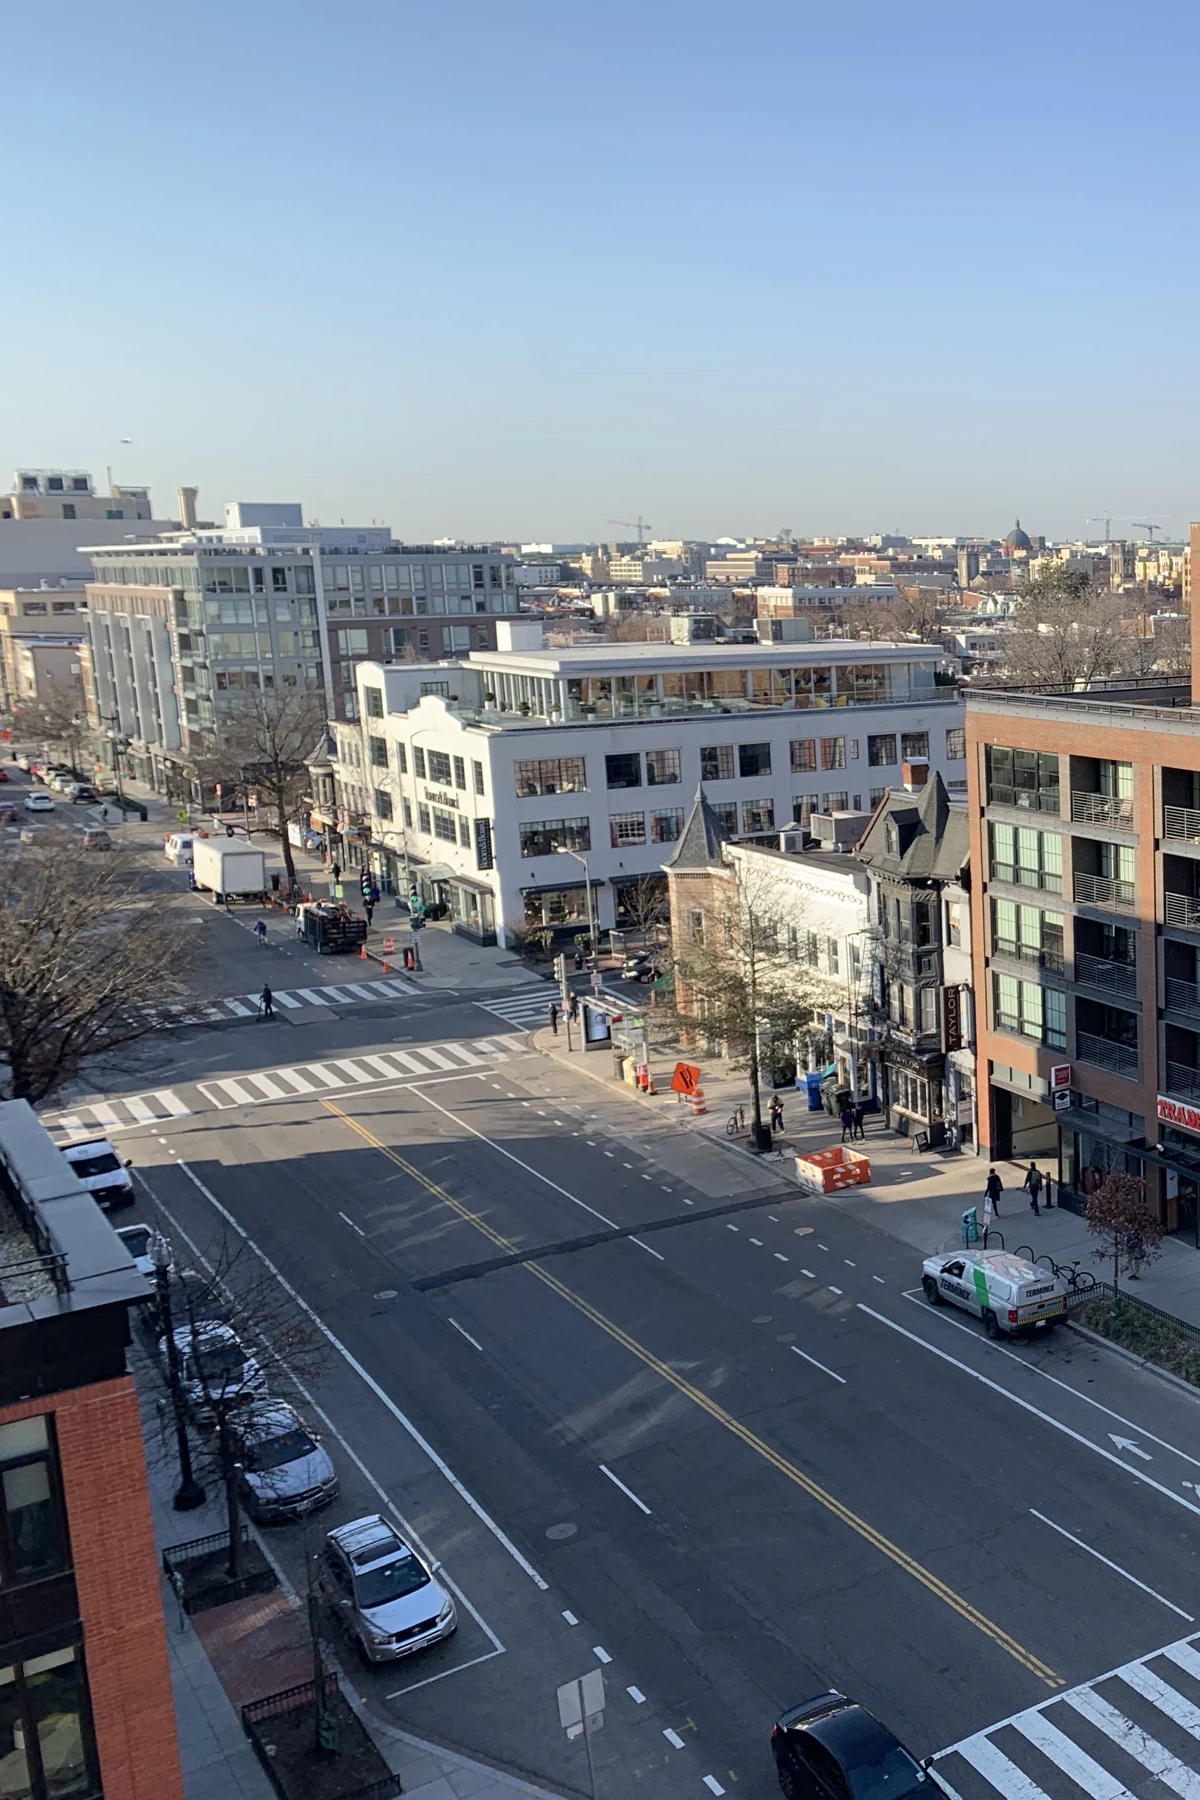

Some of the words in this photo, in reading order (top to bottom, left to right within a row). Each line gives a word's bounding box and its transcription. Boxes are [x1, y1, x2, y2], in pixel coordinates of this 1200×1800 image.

[476, 820, 489, 869] Room&Board
[948, 988, 957, 1044] TAYLOR
[940, 1277, 971, 1303] TERMINIX
[1025, 1284, 1055, 1299] TERMINIX
